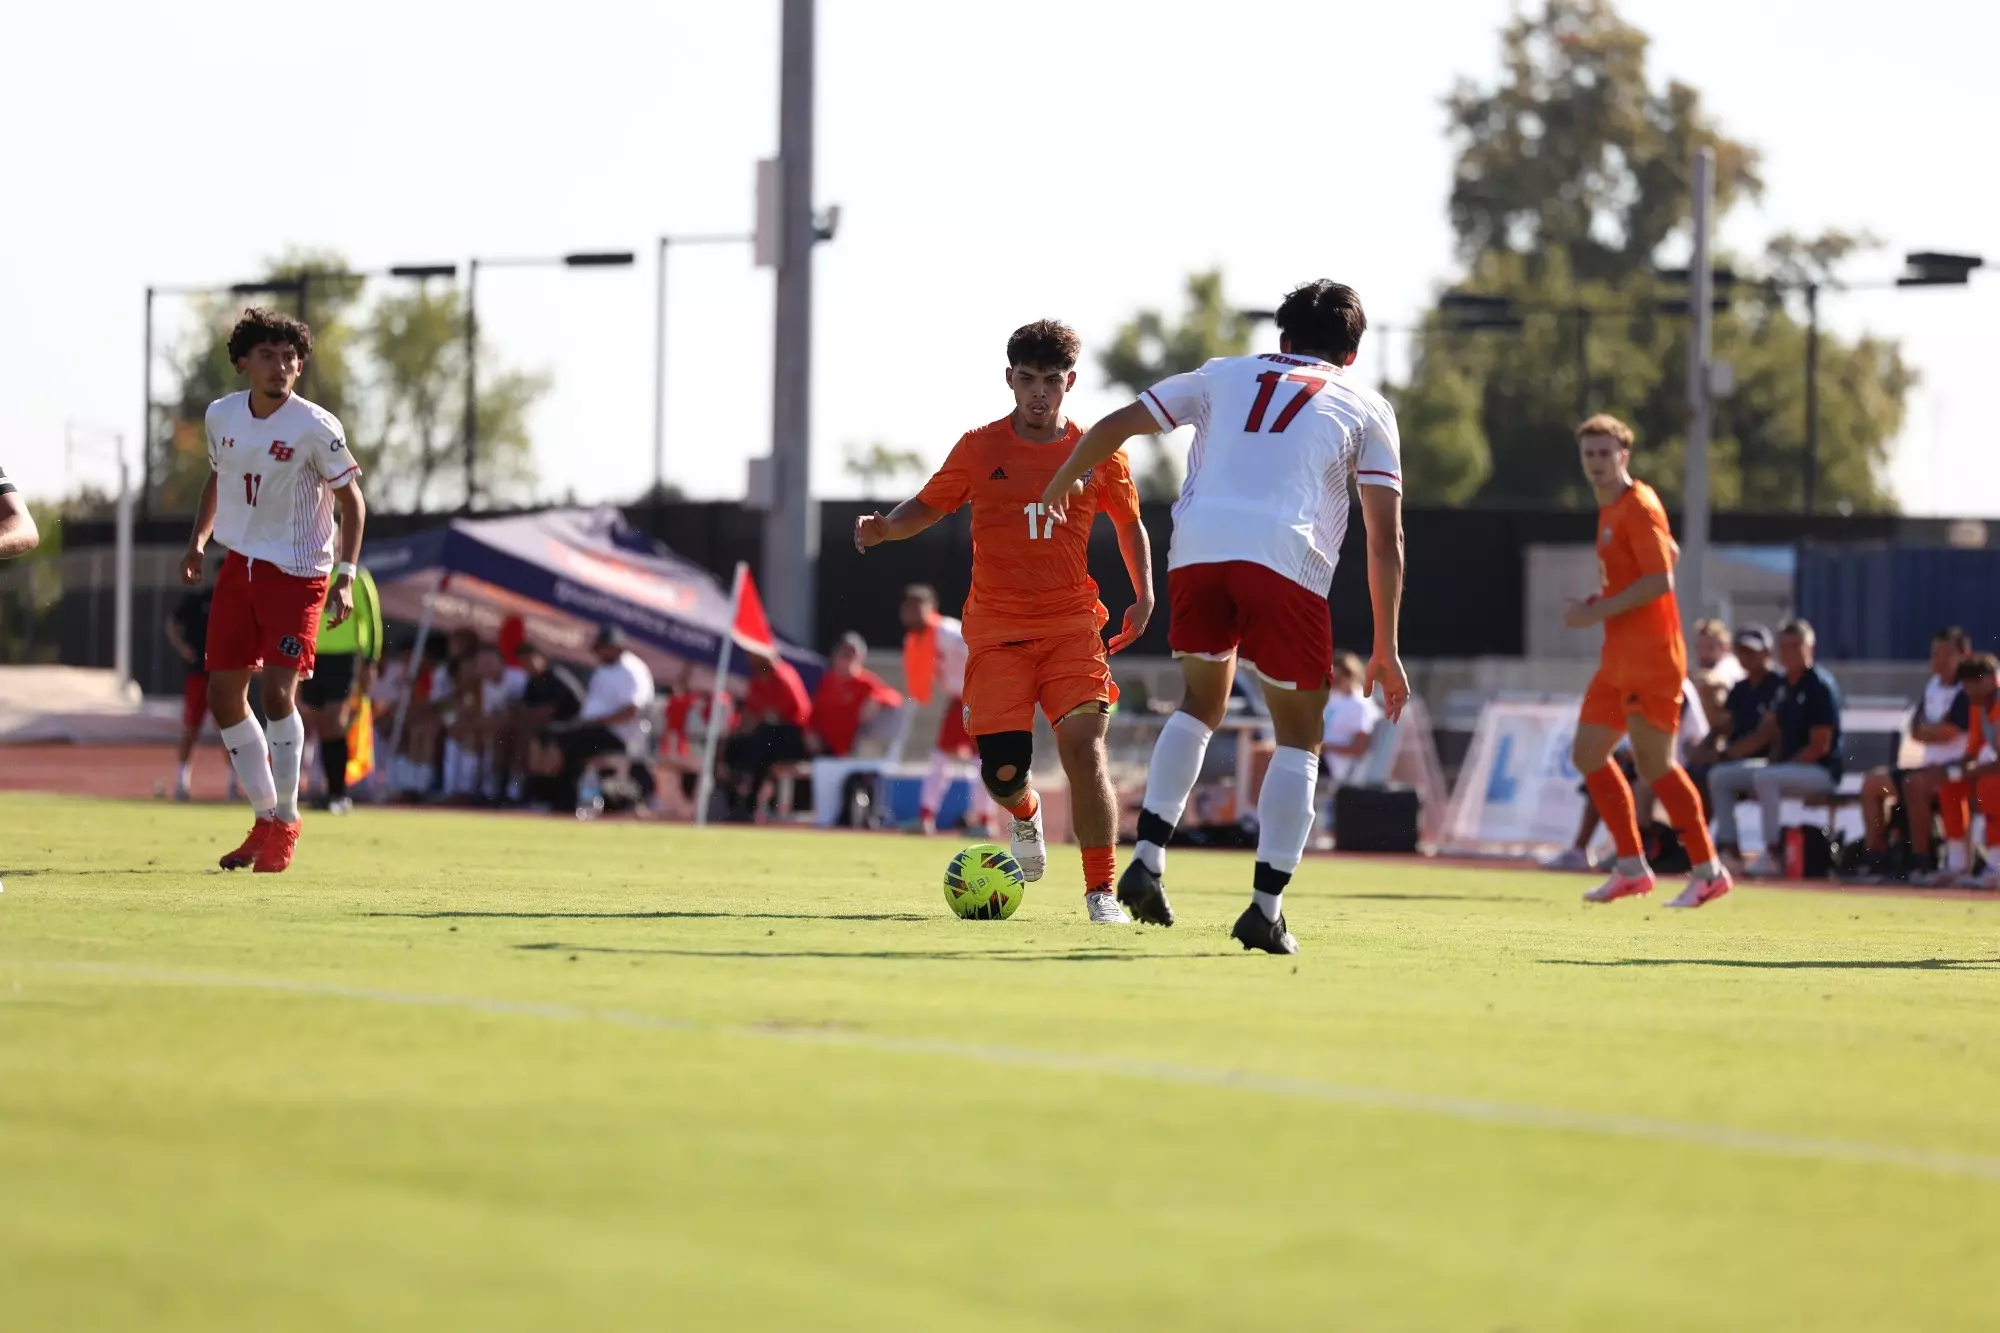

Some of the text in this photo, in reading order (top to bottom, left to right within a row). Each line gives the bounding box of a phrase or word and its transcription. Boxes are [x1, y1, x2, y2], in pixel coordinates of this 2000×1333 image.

[1243, 370, 1327, 433] 17
[268, 439, 295, 462] EB
[243, 472, 262, 507] 11
